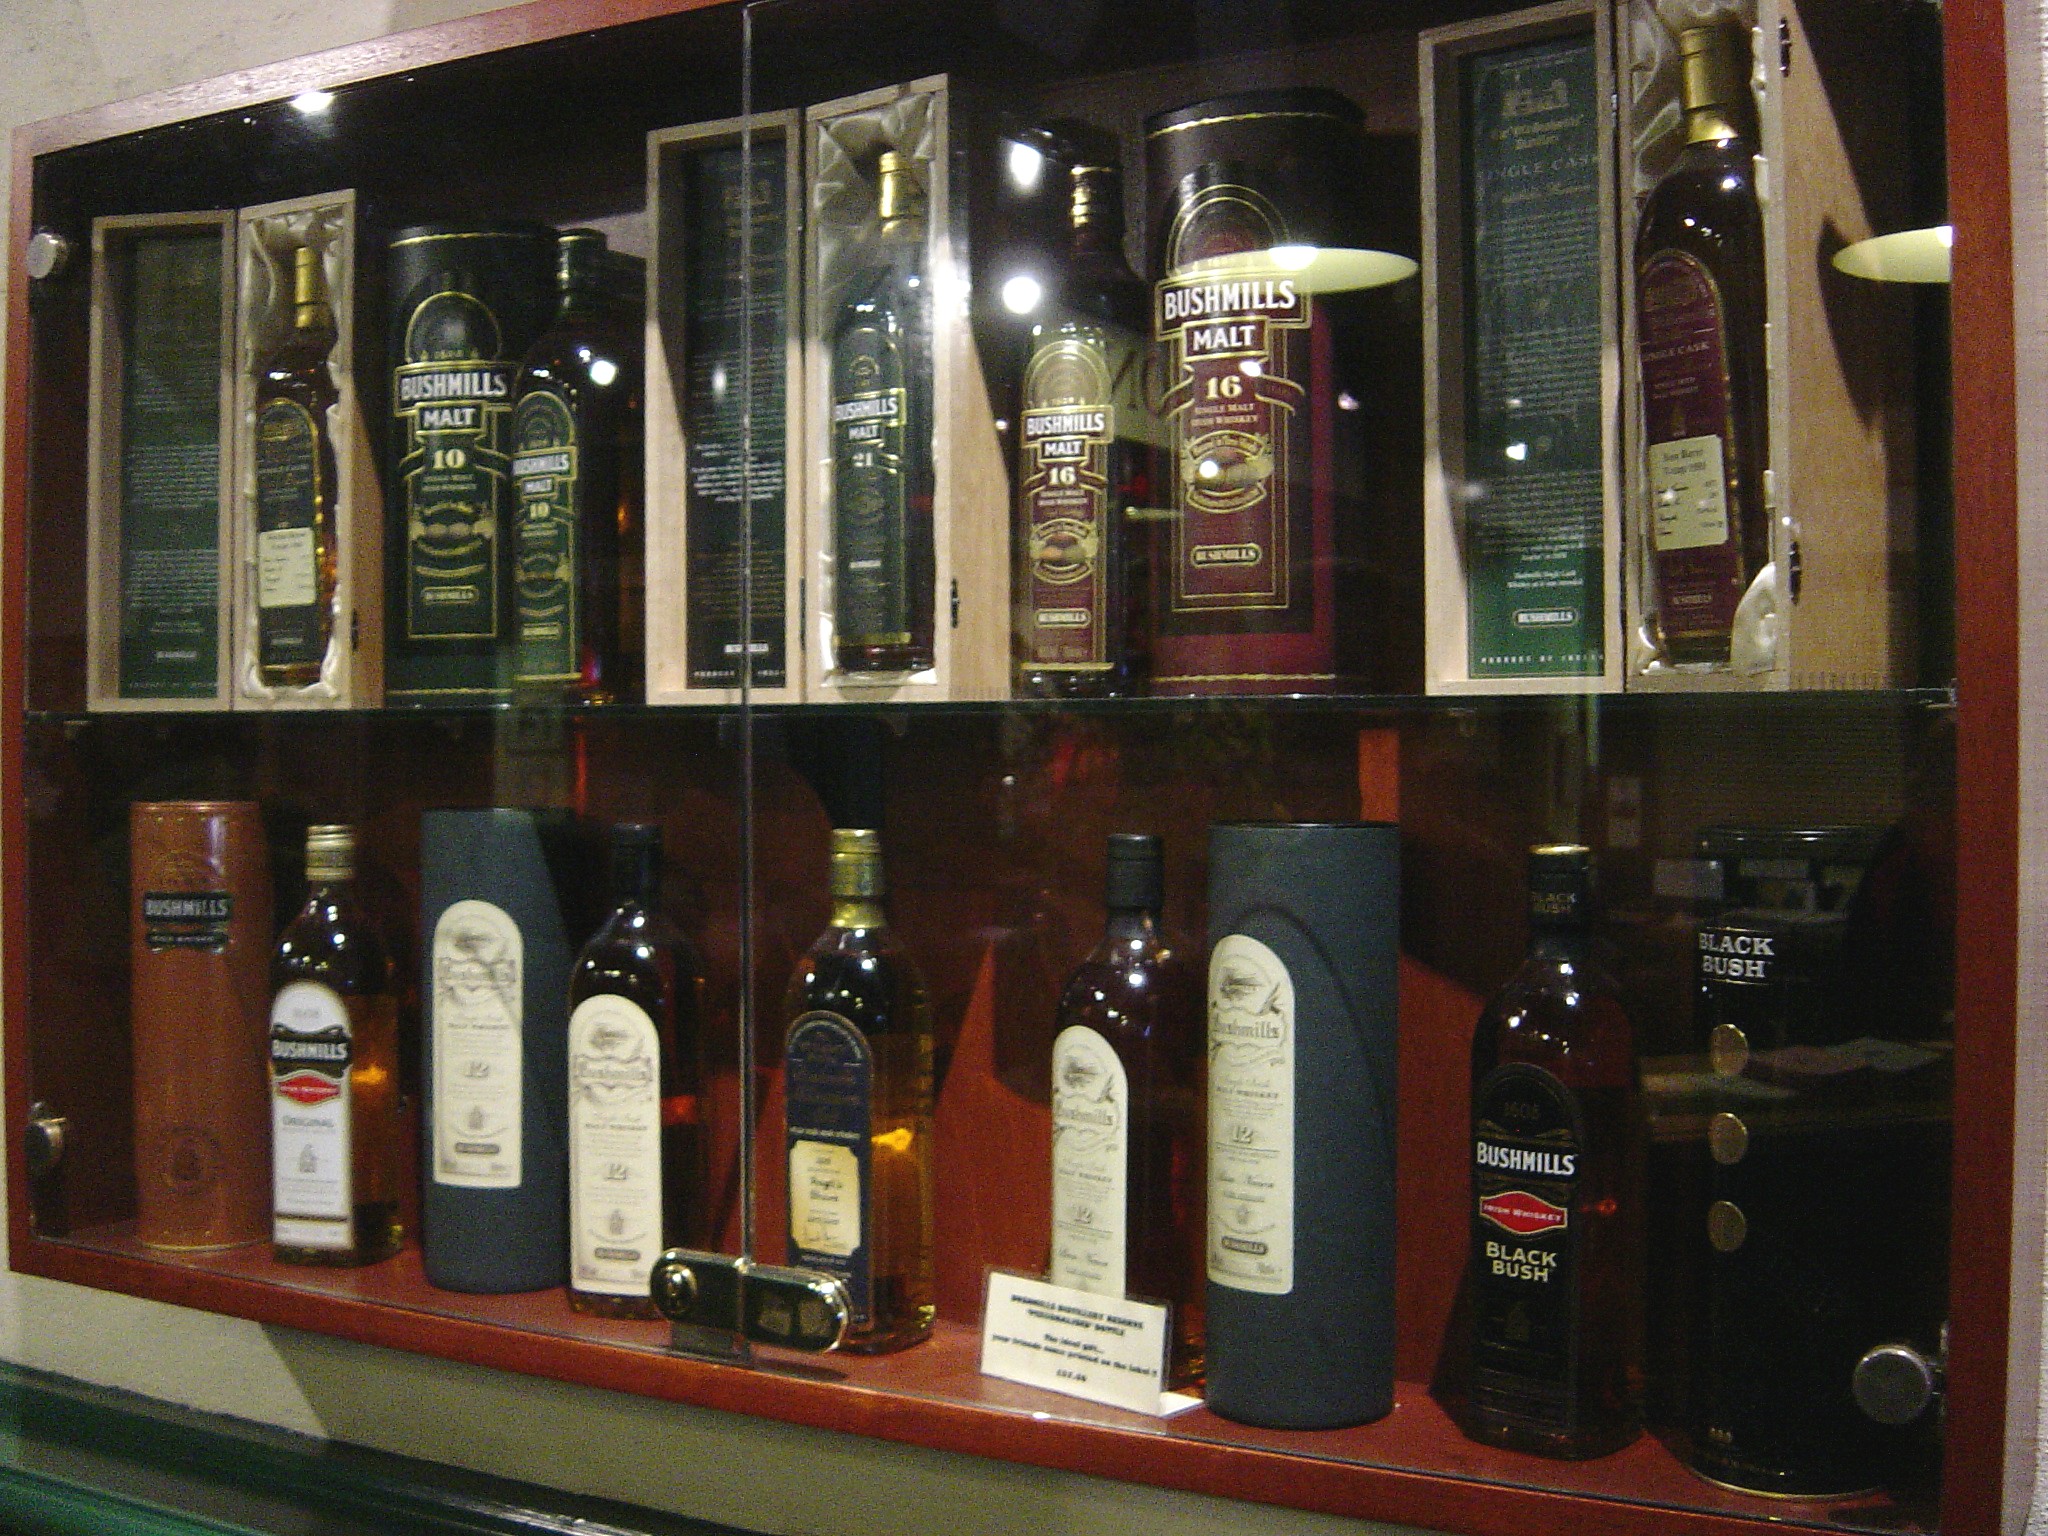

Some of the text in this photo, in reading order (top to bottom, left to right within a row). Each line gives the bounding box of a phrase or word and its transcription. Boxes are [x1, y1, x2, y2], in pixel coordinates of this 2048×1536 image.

[1164, 280, 1296, 321] BUSHMILLS
[1192, 325, 1257, 351] MALT
[401, 372, 508, 400] BUSHMILLS
[1205, 375, 1243, 399] 16
[423, 408, 477, 430] MALT
[1027, 412, 1105, 436] BUSHMILLS
[433, 449, 466, 469] 10
[1044, 441, 1082, 457] MALT
[1049, 466, 1076, 486] 16
[530, 502, 550, 518] 10
[145, 899, 227, 916] BUSHMILLS
[1698, 932, 1775, 956] BLACK
[1702, 955, 1766, 978] BUSH
[272, 1039, 348, 1059] BUSHMILLS
[1232, 1125, 1254, 1144] 12
[1476, 1142, 1576, 1176] BUSHMILLS
[1512, 1207, 1563, 1222] WHISKEY
[1486, 1240, 1558, 1268] BLACK
[1492, 1259, 1549, 1284] BUSH
